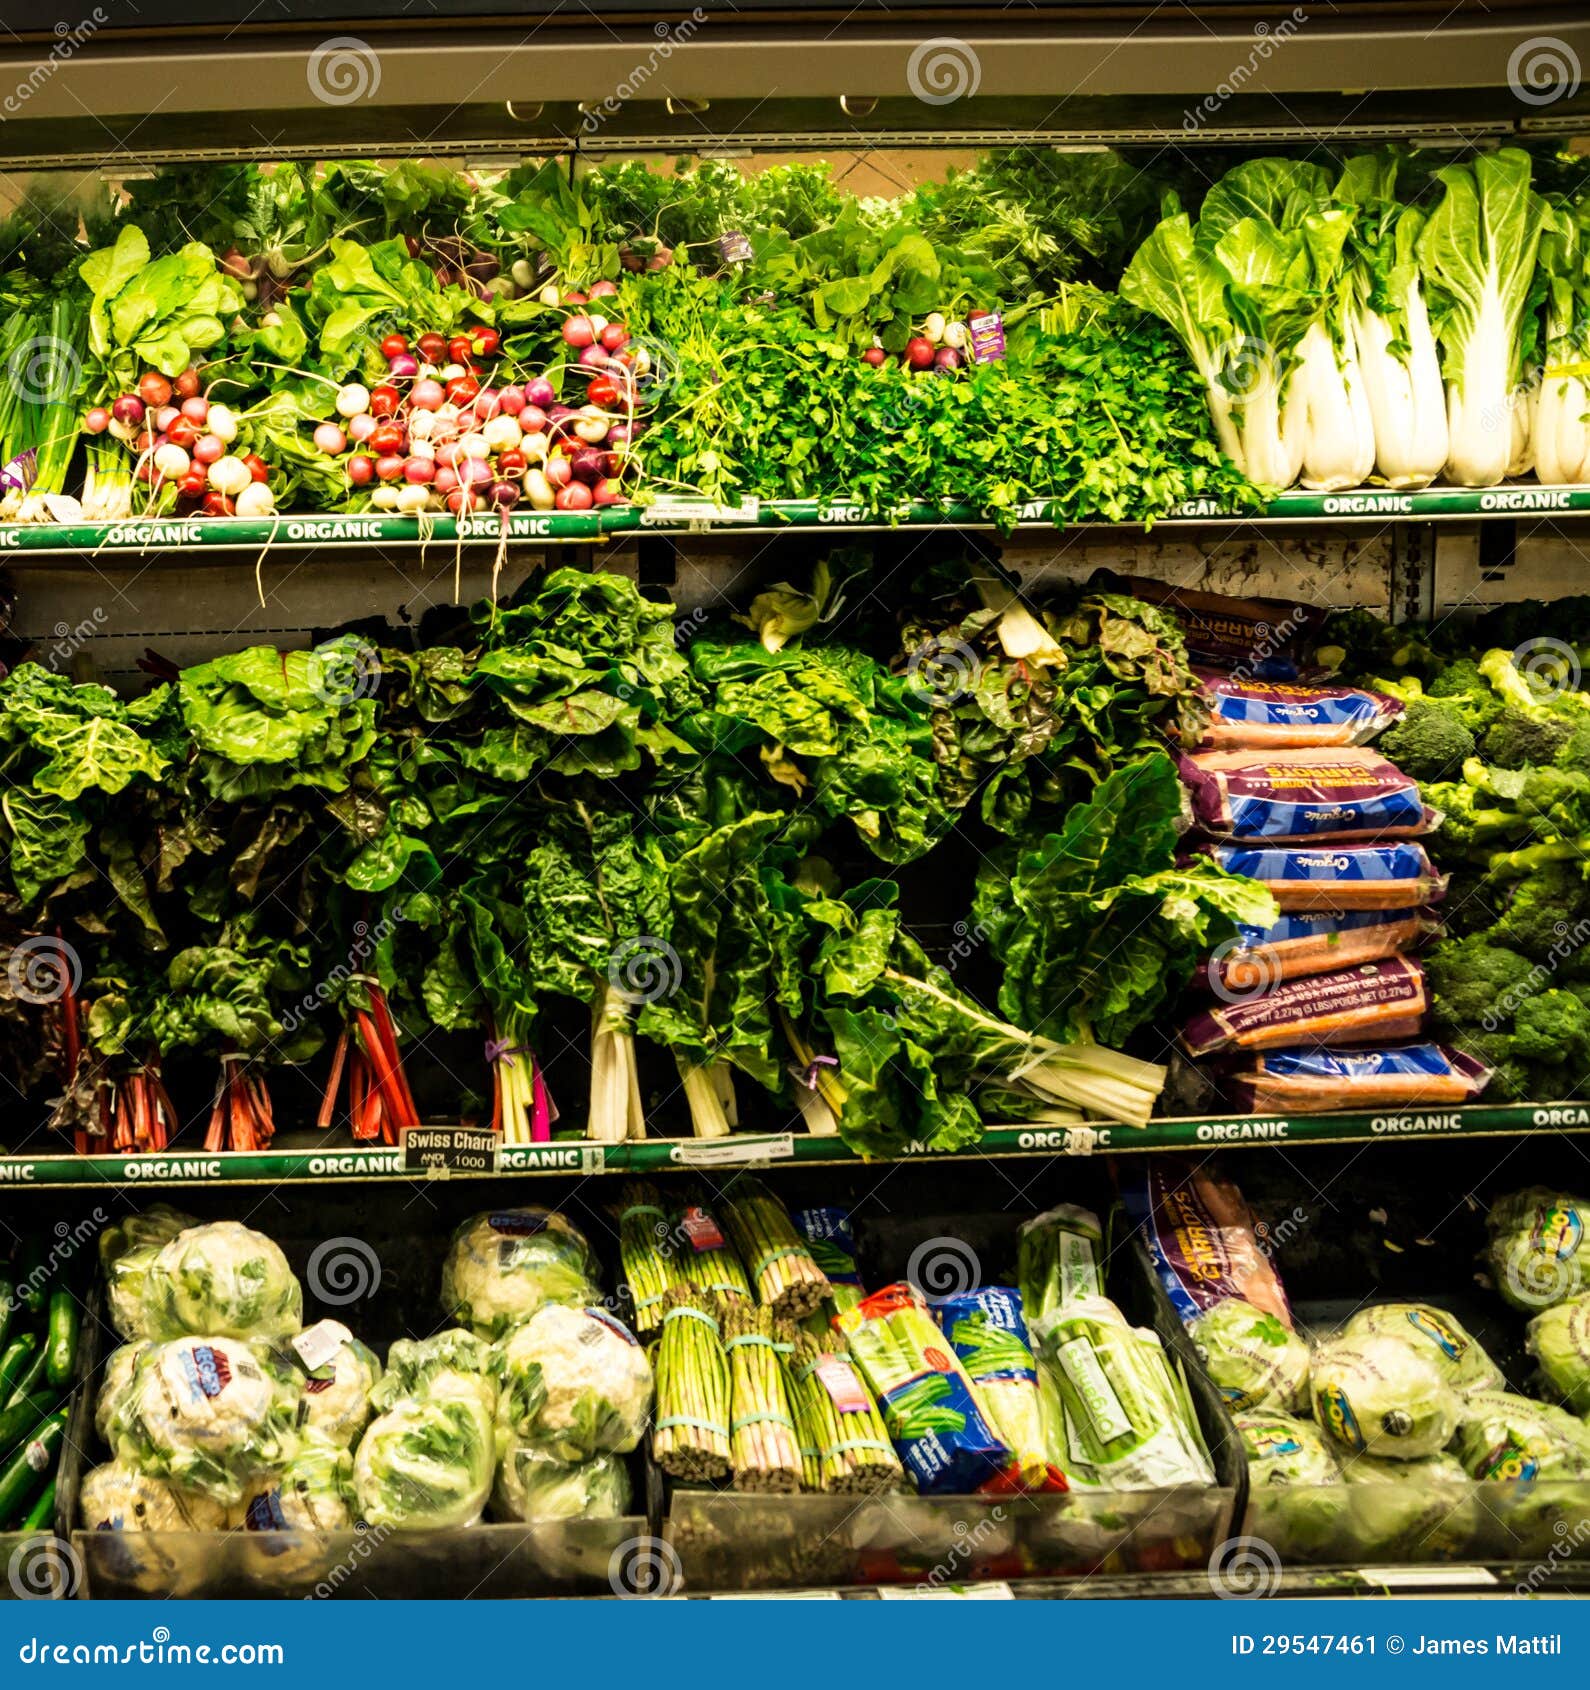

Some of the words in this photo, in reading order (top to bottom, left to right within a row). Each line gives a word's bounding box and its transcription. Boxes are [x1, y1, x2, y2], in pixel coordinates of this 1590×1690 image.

[1323, 496, 1413, 513] ORGANIC
[1480, 492, 1571, 510] ORGANIC
[108, 526, 202, 544] ORGANIC
[287, 522, 382, 539] ORGANIC
[455, 519, 550, 537] ORGANIC
[1304, 807, 1356, 822] Organic
[1296, 853, 1349, 871] Organic
[1371, 1114, 1462, 1132] ORGANIC
[1533, 1109, 1590, 1126] ORGA
[1018, 1130, 1111, 1148] ORGAIC
[1197, 1122, 1289, 1140] ORGANIC
[408, 1131, 451, 1149] Swiss
[453, 1132, 496, 1152] Chard
[455, 1154, 486, 1169] 1000
[500, 1151, 578, 1168] RGANIC
[124, 1161, 221, 1179] ORGANIC
[1174, 1191, 1221, 1279] CARROTS
[1066, 1348, 1114, 1435] Organics
[909, 1443, 936, 1481] Hearts
[918, 1437, 942, 1472] Celery
